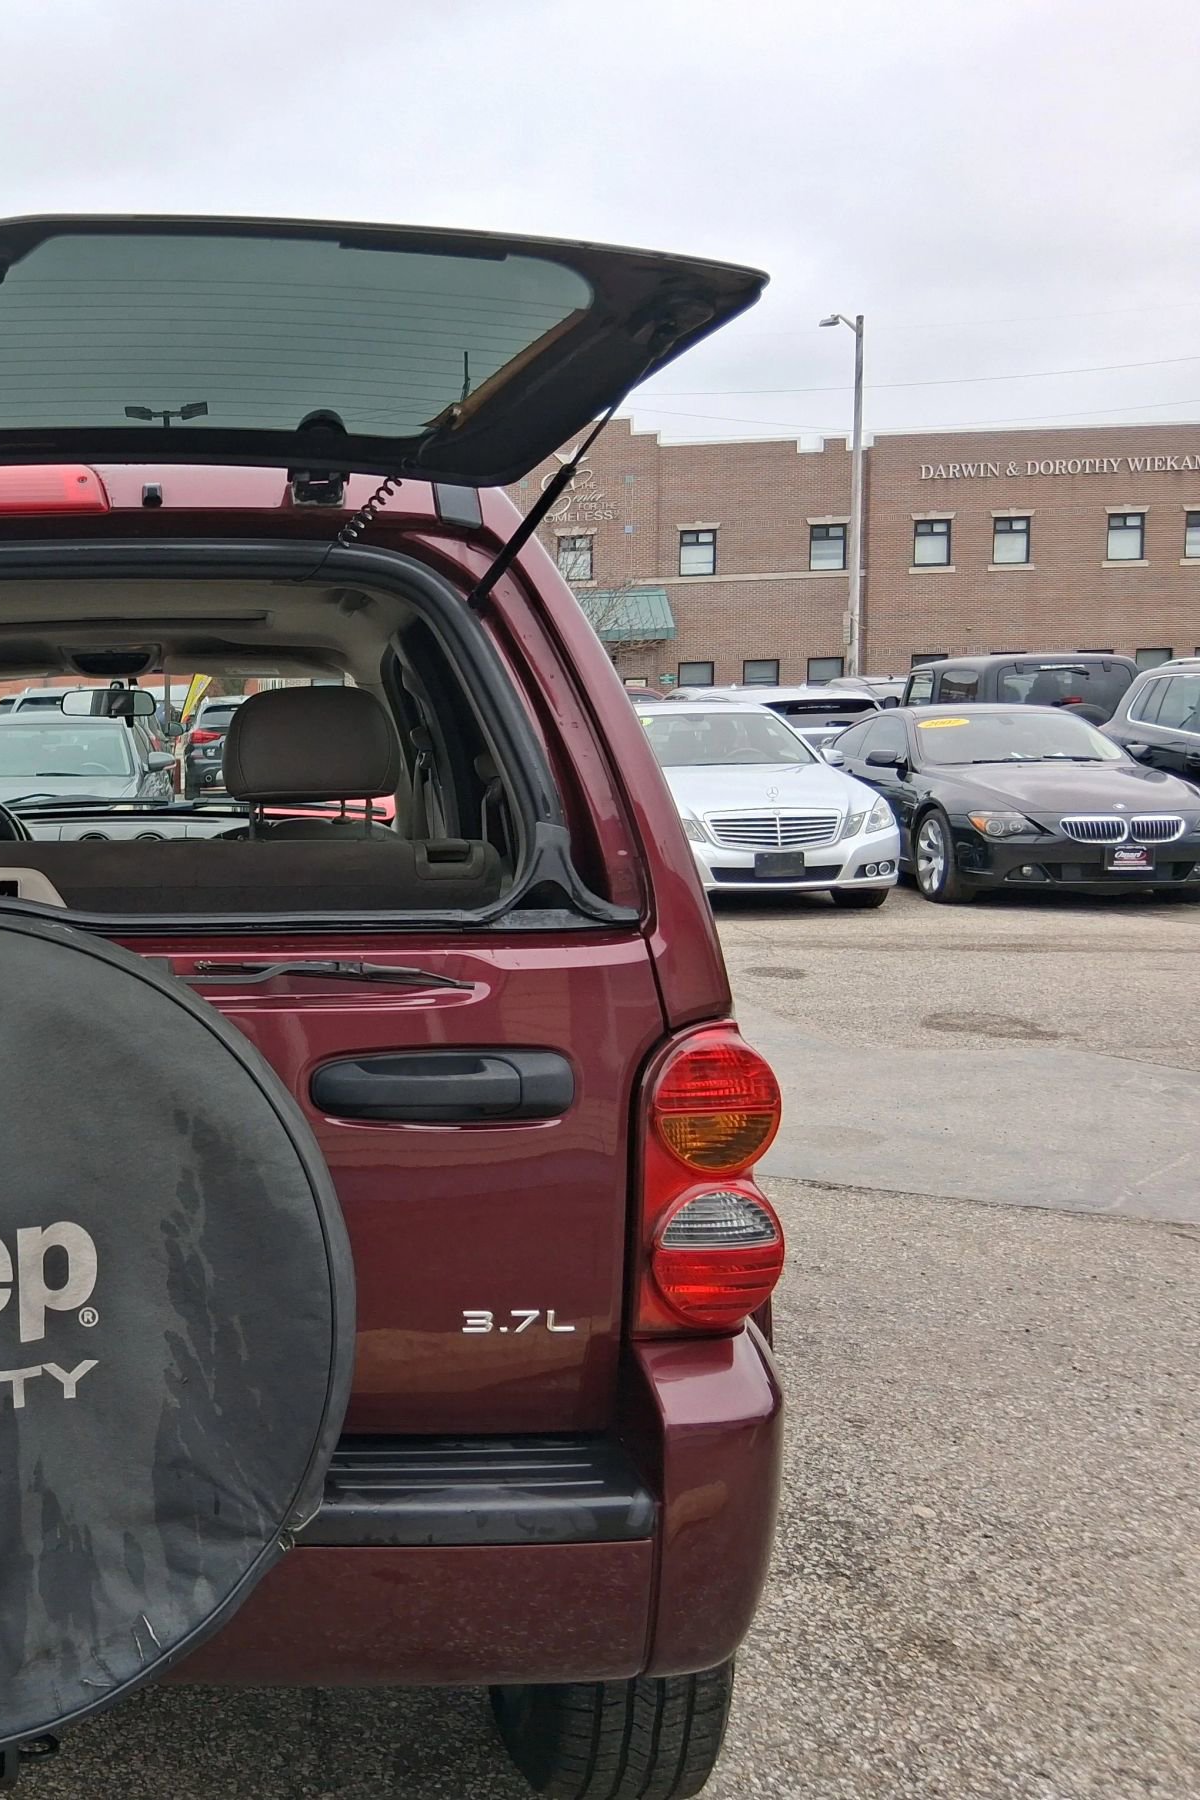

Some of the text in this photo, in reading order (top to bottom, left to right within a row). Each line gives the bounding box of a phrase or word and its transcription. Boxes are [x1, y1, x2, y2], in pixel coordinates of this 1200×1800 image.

[920, 462, 1001, 479] DARWIN
[1006, 461, 1020, 476] &
[1026, 458, 1122, 475] DOROTHY
[579, 502, 597, 511] FOR
[544, 510, 614, 522] OMELESS
[462, 1309, 576, 1333] 3.7L
